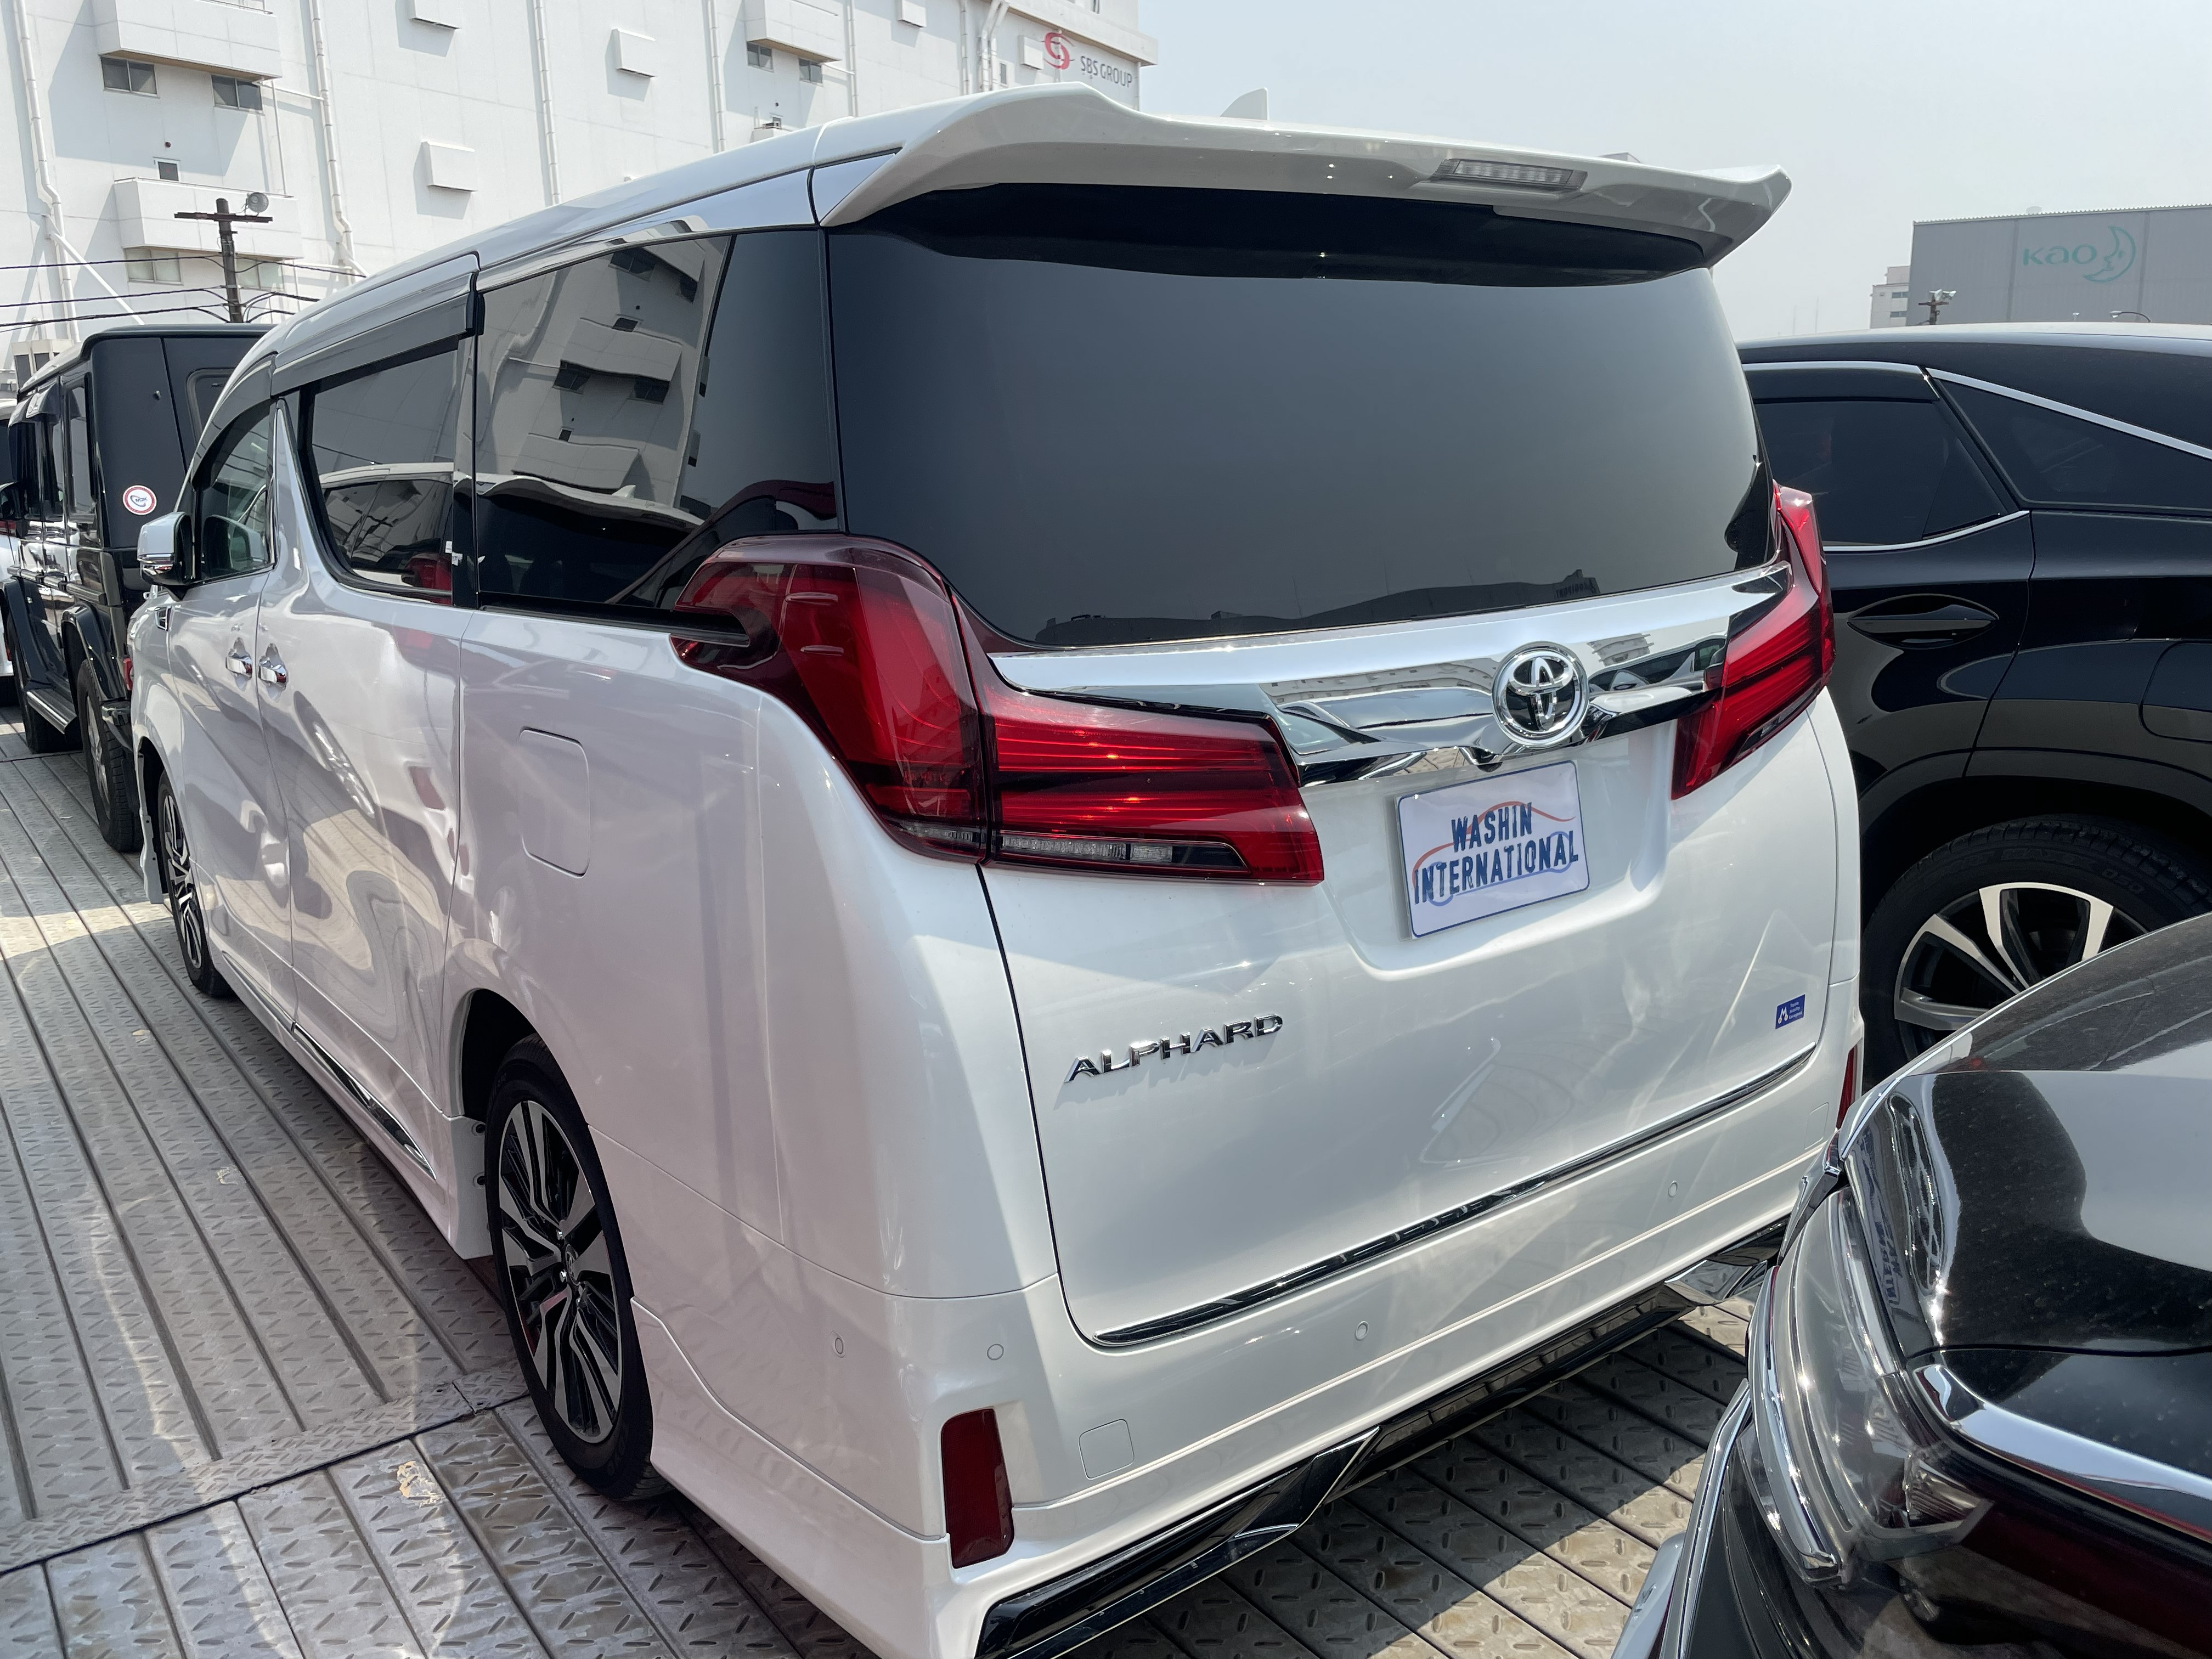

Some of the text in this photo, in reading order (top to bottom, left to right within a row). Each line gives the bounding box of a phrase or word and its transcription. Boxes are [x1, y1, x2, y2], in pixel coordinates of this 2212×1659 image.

[1080, 55, 1133, 88] SBS GROUP
[1451, 802, 1532, 853] WASHIN
[1414, 830, 1579, 905] INTERNATIONAL
[1063, 1013, 1283, 1084] ALPHARD
